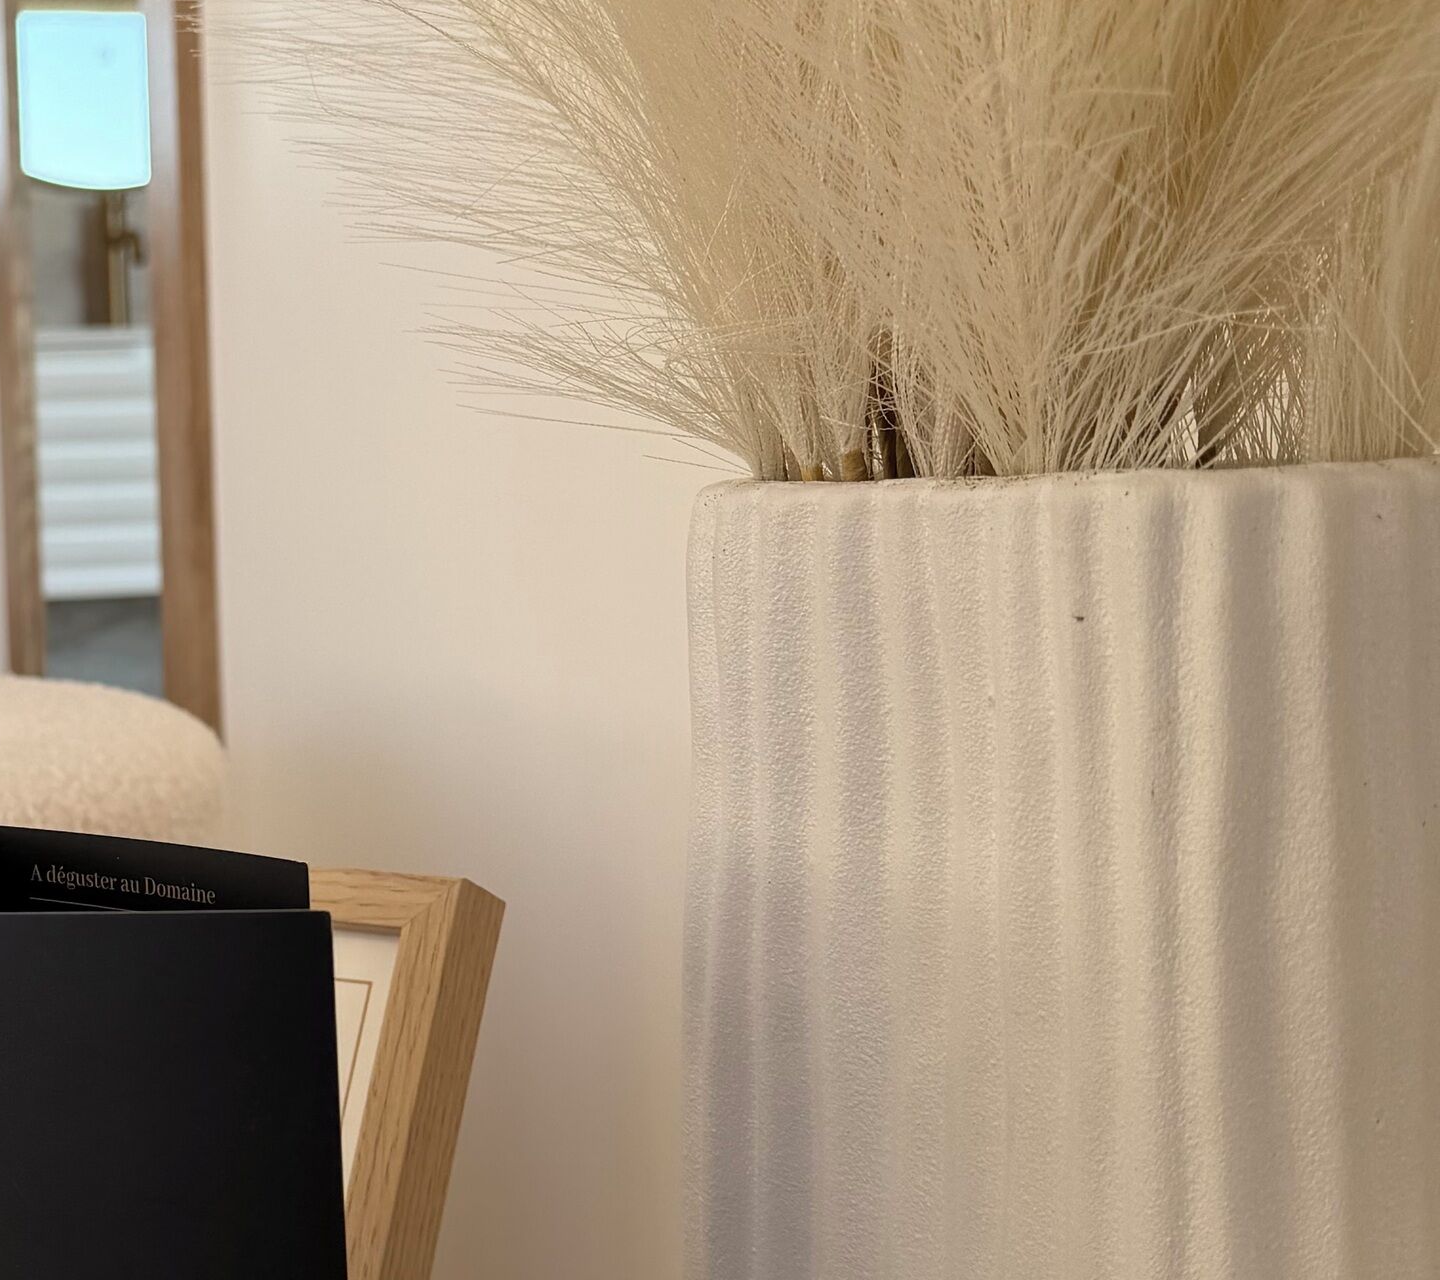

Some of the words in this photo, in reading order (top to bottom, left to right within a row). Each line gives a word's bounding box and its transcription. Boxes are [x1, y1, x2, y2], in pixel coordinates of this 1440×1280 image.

[31, 863, 43, 882] A
[46, 864, 118, 891] déguster
[120, 879, 140, 895] au
[144, 876, 216, 905] Domaine
